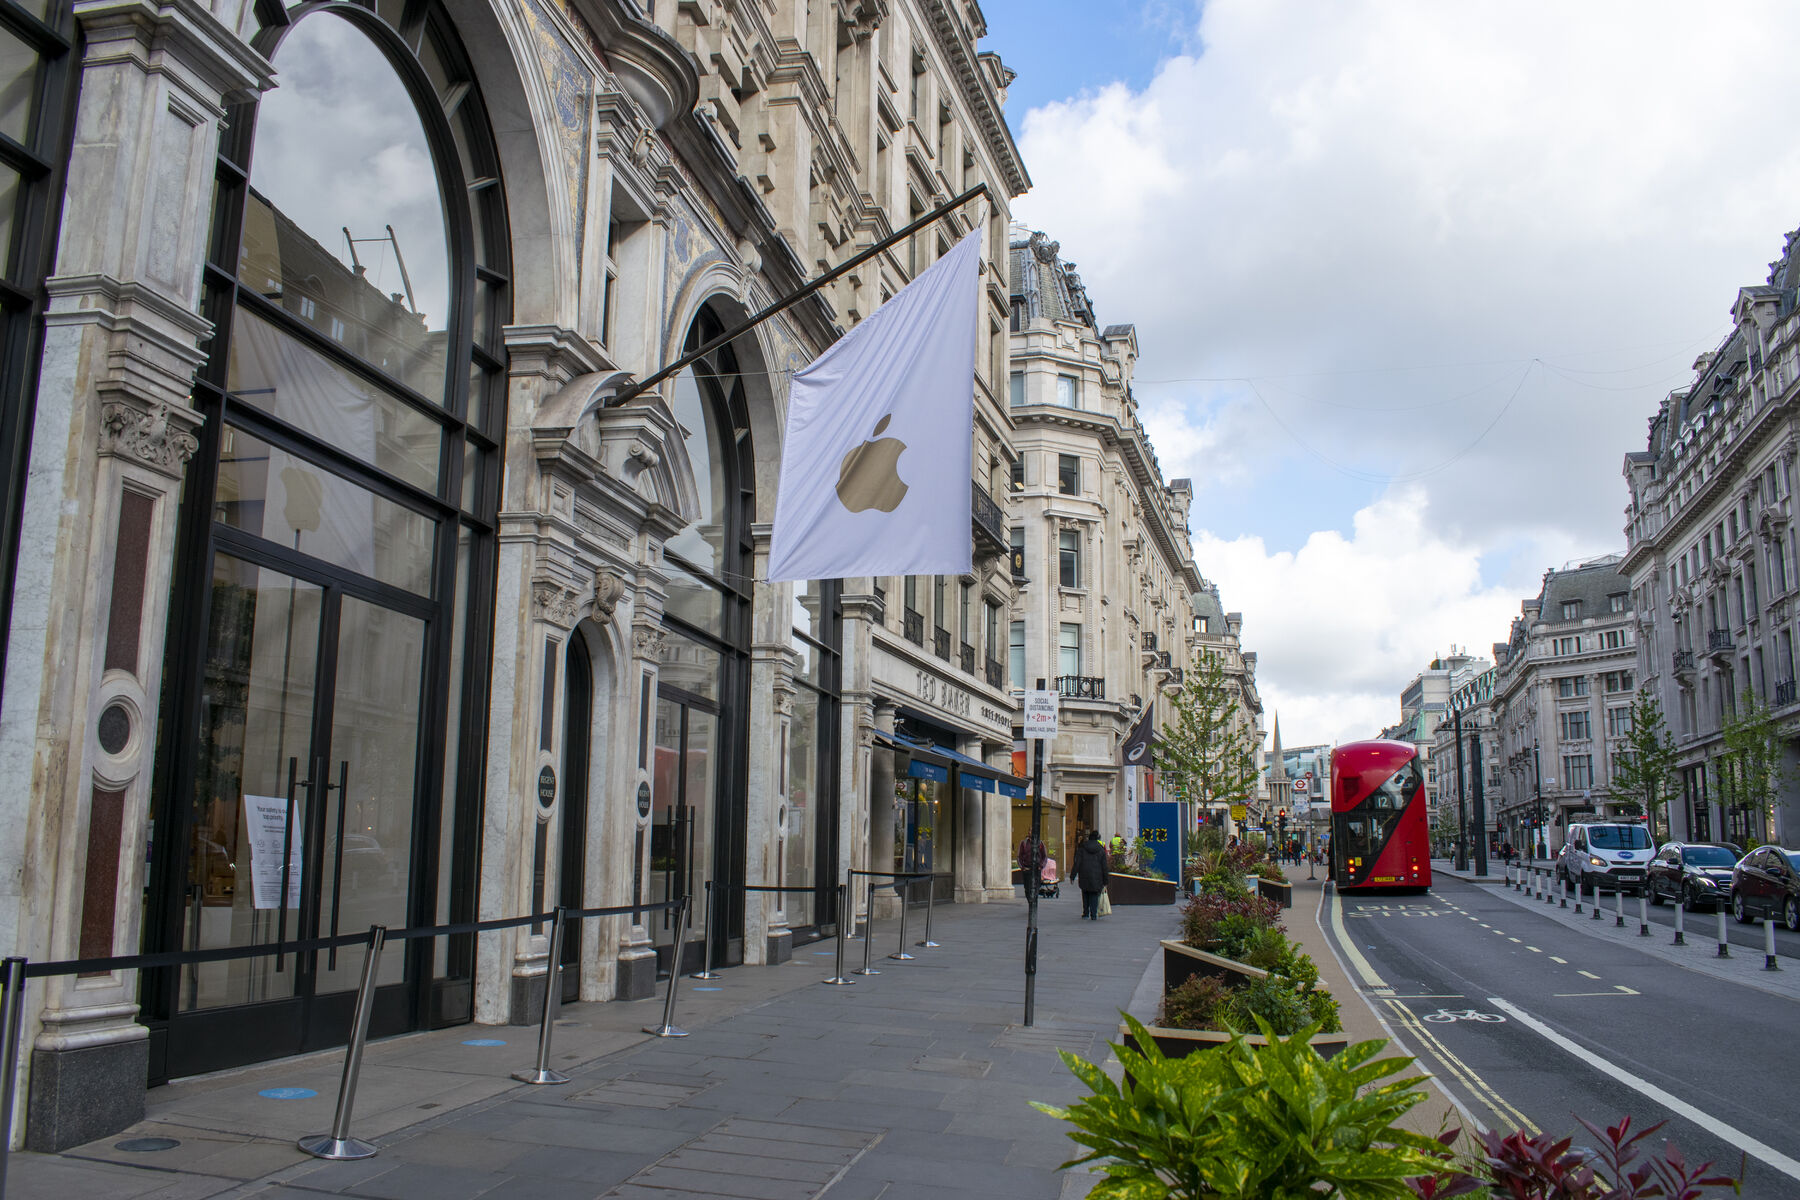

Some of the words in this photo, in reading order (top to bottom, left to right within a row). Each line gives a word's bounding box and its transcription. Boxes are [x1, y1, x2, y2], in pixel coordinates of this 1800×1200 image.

[917, 670, 936, 702] TED
[941, 683, 970, 717] BAKER
[1036, 713, 1046, 722] 2m
[540, 775, 555, 784] REGENT
[540, 788, 554, 797] HOUSE
[639, 801, 649, 809] HOUSE
[1378, 796, 1388, 808] 12
